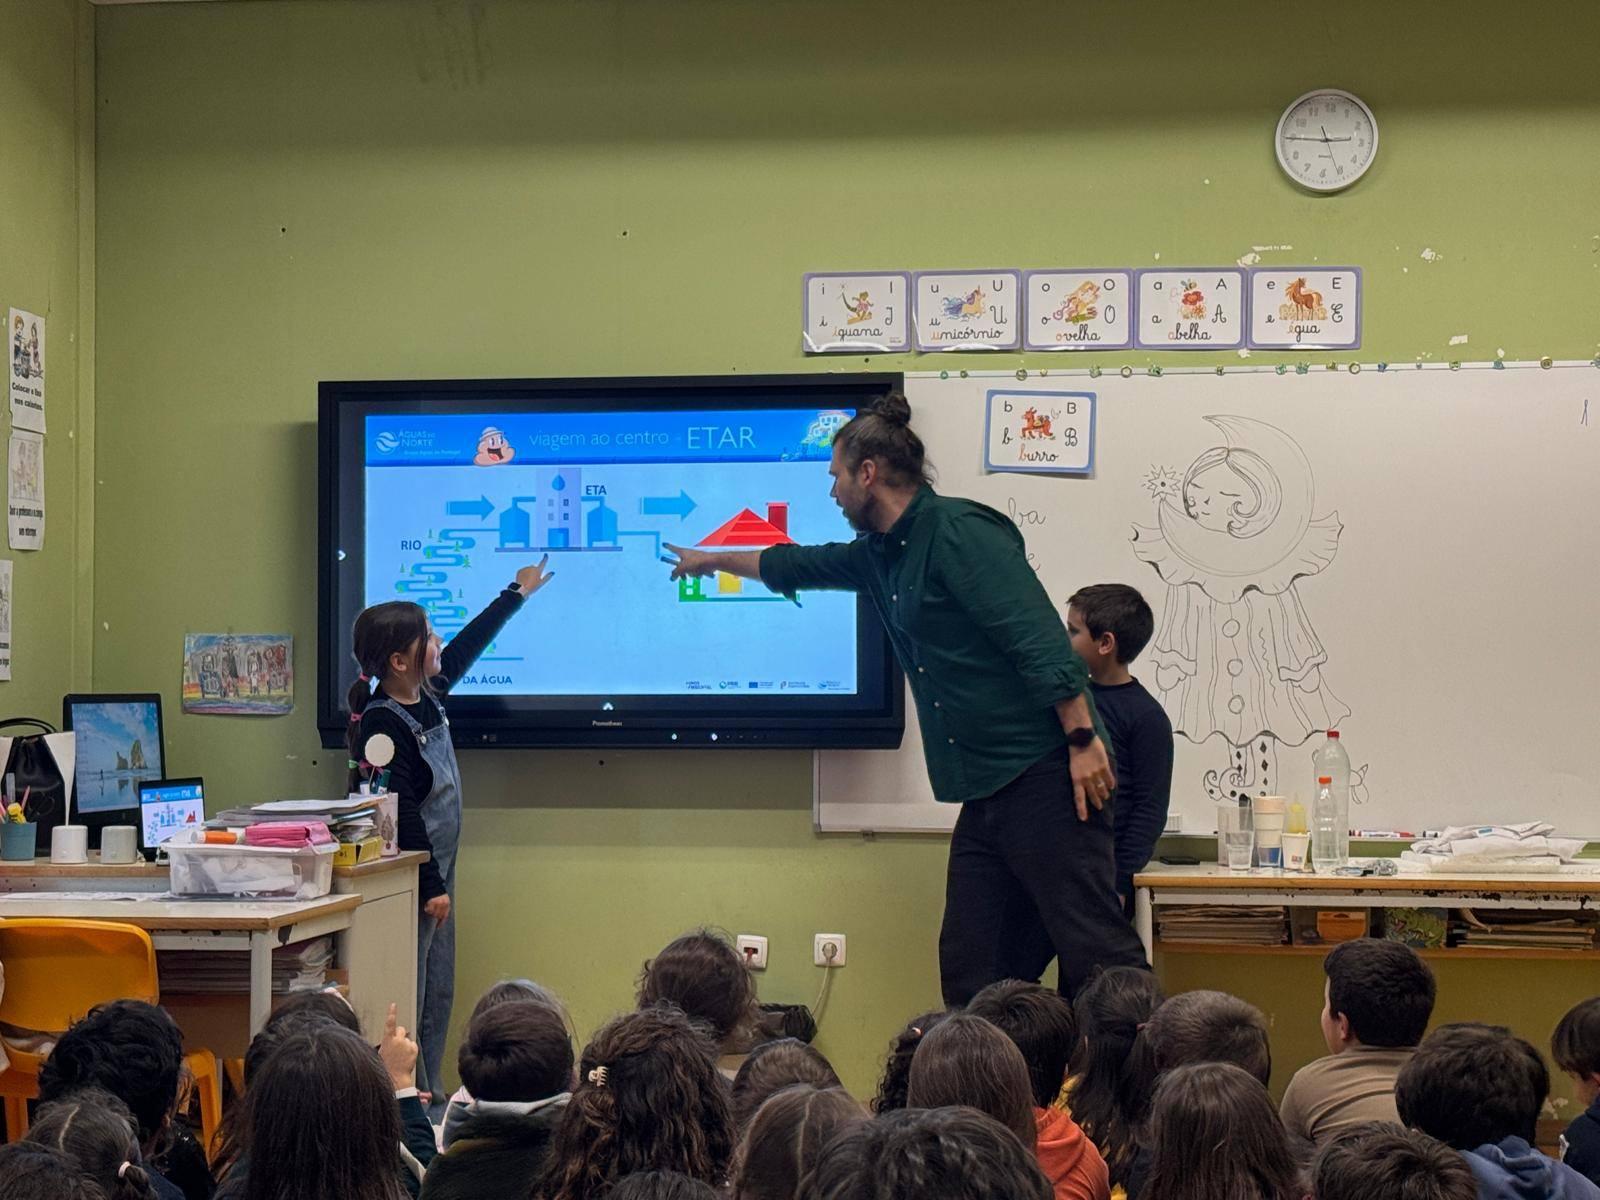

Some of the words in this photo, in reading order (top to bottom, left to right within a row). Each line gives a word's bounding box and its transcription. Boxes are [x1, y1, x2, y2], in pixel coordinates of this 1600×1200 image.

[931, 284, 939, 293] u
[993, 280, 1003, 292] U
[1042, 283, 1050, 292] o
[1104, 279, 1115, 291] O
[1153, 281, 1162, 290] a
[1216, 278, 1227, 290] A
[1266, 280, 1275, 290] e
[1332, 277, 1342, 289] E
[990, 305, 1007, 324] U
[1104, 304, 1116, 324] O
[1152, 314, 1162, 324] a
[1212, 304, 1227, 324] A
[1265, 314, 1275, 324] e
[1331, 303, 1343, 323] E
[832, 323, 883, 343] iguana
[931, 325, 1004, 340] unicórnio
[1056, 323, 1101, 341] ovelha
[1167, 323, 1211, 341] abelha
[1004, 401, 1013, 413] b
[1067, 402, 1077, 414] B
[528, 429, 585, 451] viagem
[590, 434, 610, 446] ao
[615, 430, 669, 445] centro
[688, 426, 757, 449] ETAR
[1064, 427, 1078, 447] B
[1018, 443, 1059, 462] burro
[585, 484, 607, 496] ETA
[401, 539, 422, 550] RIO
[463, 675, 478, 685] DA
[481, 673, 513, 685] ÁGUA
